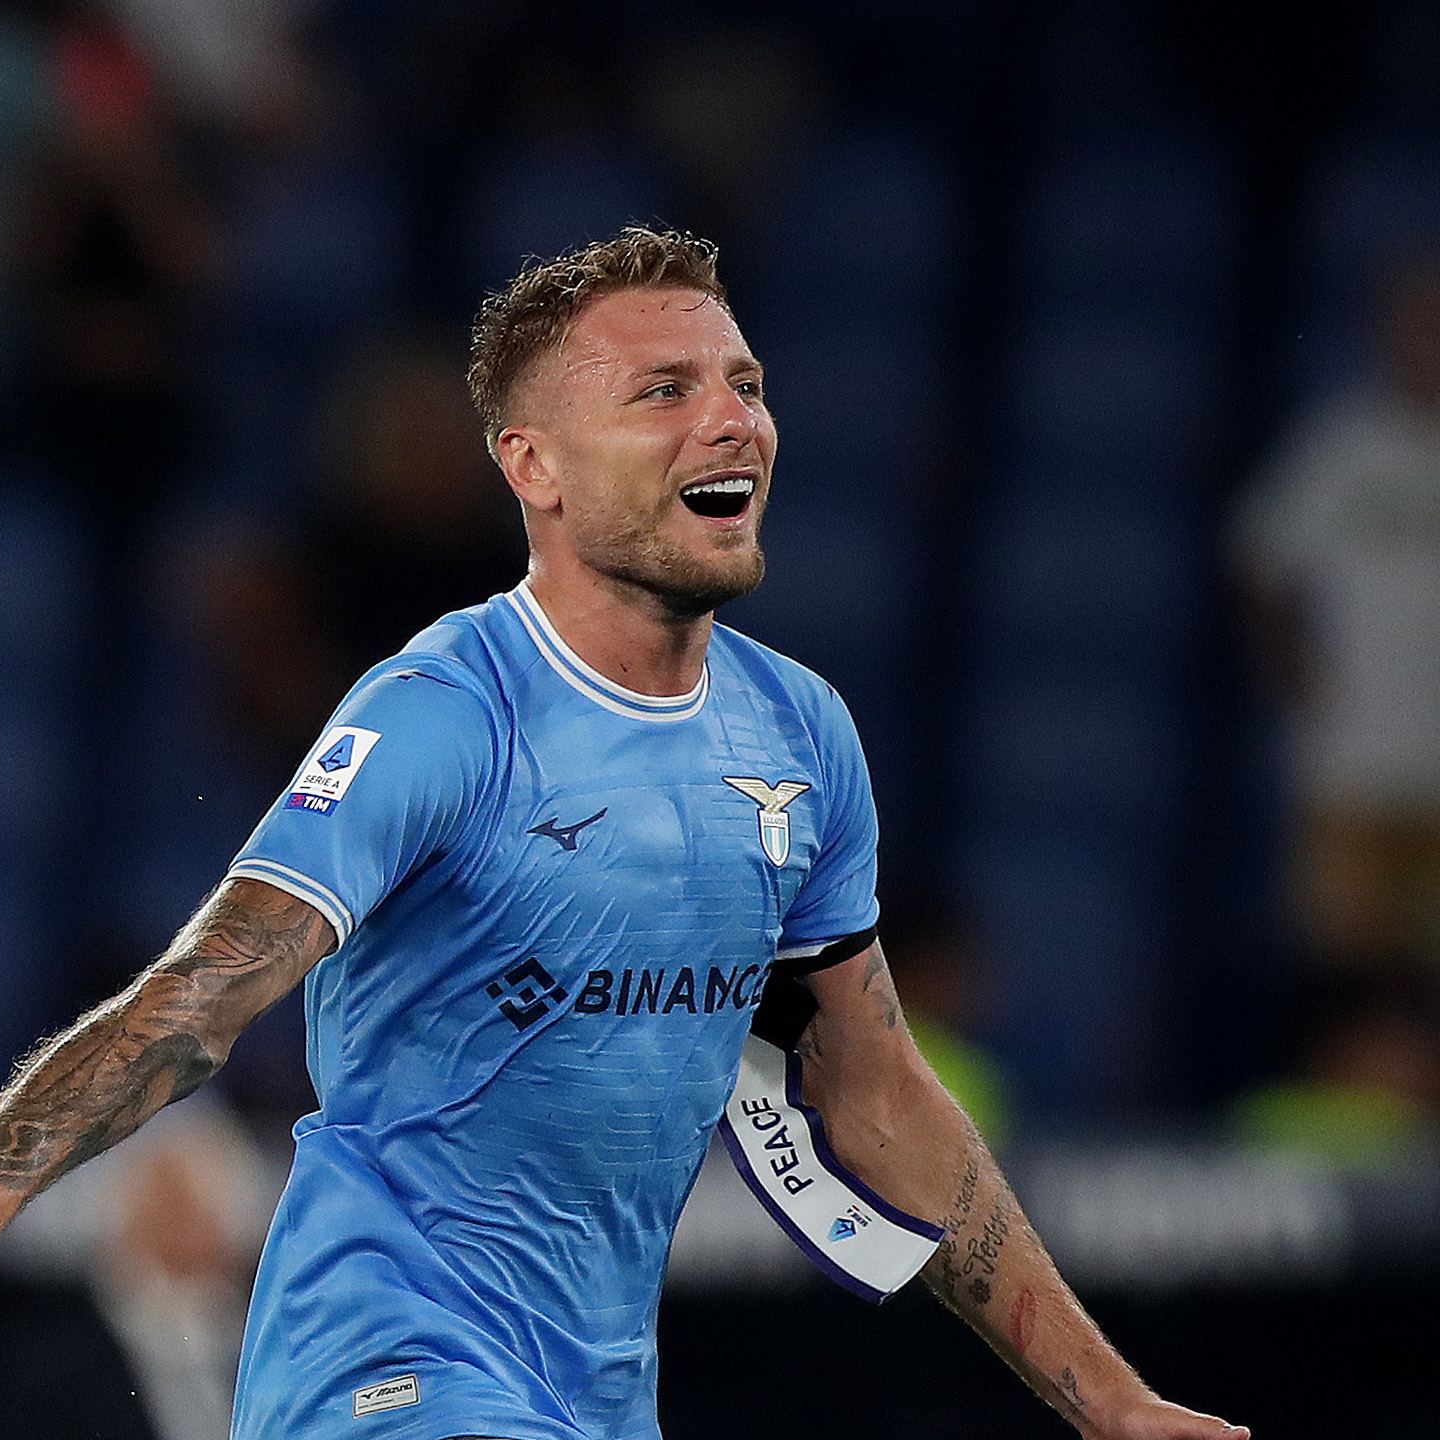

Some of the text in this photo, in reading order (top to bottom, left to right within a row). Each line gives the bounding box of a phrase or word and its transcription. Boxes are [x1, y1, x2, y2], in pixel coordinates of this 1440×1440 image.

[303, 774, 340, 789] SERIE A
[303, 795, 331, 813] TIM
[741, 1097, 814, 1195] PEACE
